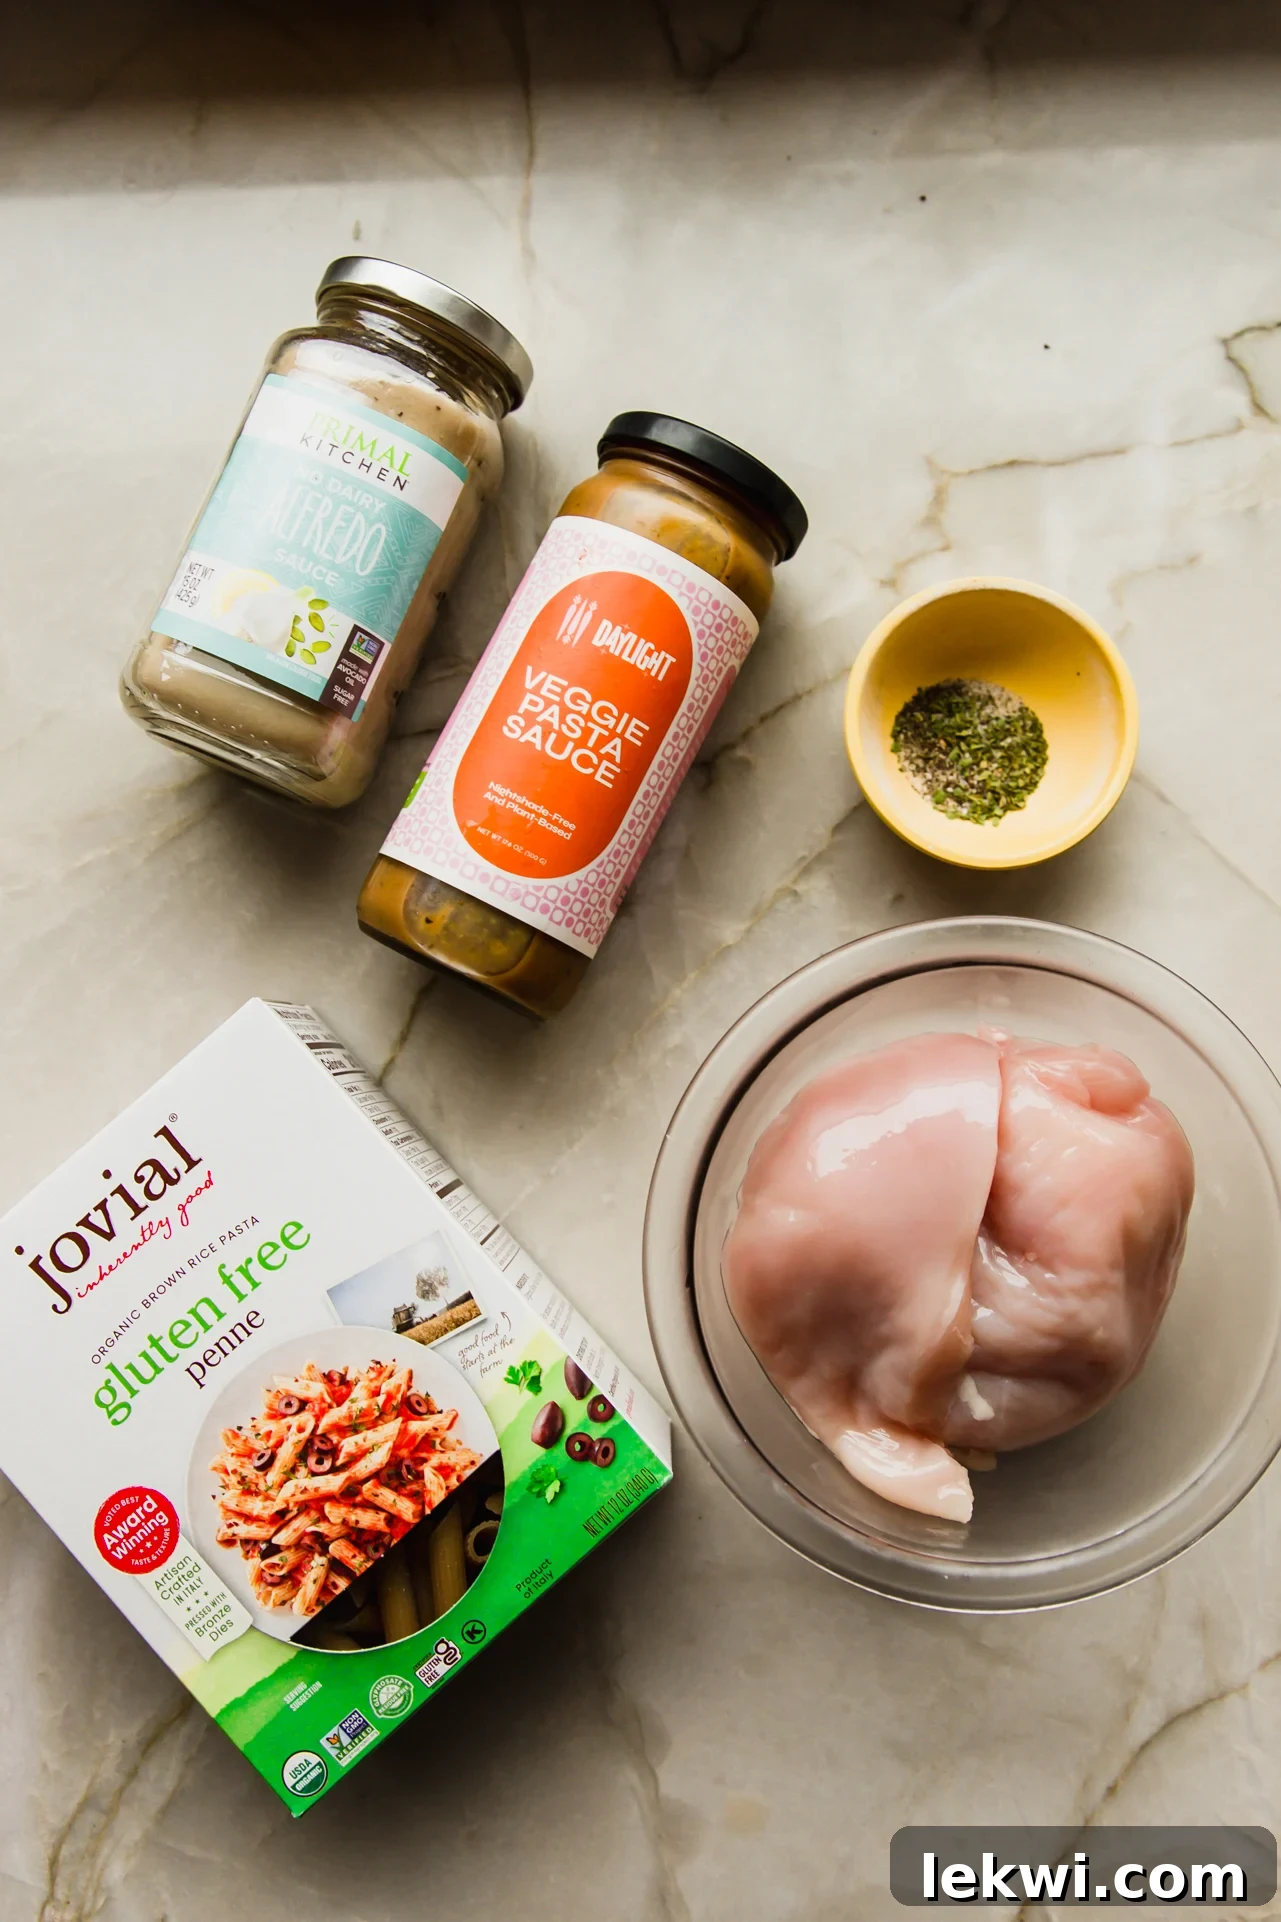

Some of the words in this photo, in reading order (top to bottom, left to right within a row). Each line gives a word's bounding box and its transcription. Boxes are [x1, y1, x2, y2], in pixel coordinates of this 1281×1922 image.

[300, 433, 408, 491] KITCHEN
[309, 411, 412, 477] PRIMAL
[325, 477, 386, 514] DAIRY
[257, 479, 387, 577] ALFREDO
[187, 561, 202, 576] NET
[189, 578, 201, 590] OZ
[273, 548, 340, 587] SAUCE
[591, 618, 677, 681] DAYLIGHT
[336, 663, 367, 684] AVOCADO
[345, 676, 355, 687] OIL
[333, 685, 355, 701] SUGAR
[333, 693, 350, 707] FREE
[524, 665, 650, 747] VEGGIE
[518, 693, 622, 764] PASTA
[502, 715, 621, 789] SAUCE
[483, 791, 507, 806] And
[506, 801, 572, 840] Plant-Based
[488, 781, 576, 831] Nightshade-Free
[476, 826, 491, 836] NET
[491, 833, 502, 842] WT
[75, 1216, 172, 1299] inherently
[177, 1170, 214, 1228] good
[91, 1308, 141, 1365] ORGANIC
[141, 1266, 187, 1310] BROWN
[187, 1243, 218, 1269] RICE
[219, 1215, 260, 1245] PASTA
[93, 1296, 227, 1426] gluten
[217, 1220, 311, 1304] free
[184, 1309, 266, 1389] penne
[458, 1334, 479, 1364] good
[481, 1322, 499, 1346] food
[487, 1343, 498, 1357] at
[499, 1334, 516, 1350] the
[103, 1503, 121, 1527] VOTED
[120, 1495, 140, 1507] BEST
[103, 1494, 158, 1551] Award
[582, 1515, 604, 1538] NET
[607, 1498, 624, 1515] 12
[616, 1488, 634, 1507] OZ
[111, 1511, 169, 1560] Winning
[131, 1556, 152, 1566] TASTE
[151, 1553, 157, 1561] &
[155, 1527, 171, 1556] TEXTURE
[154, 1555, 193, 1591] Artisan
[160, 1561, 202, 1600] Crafted
[173, 1594, 185, 1606] IN
[182, 1576, 204, 1598] ITALY
[515, 1558, 552, 1592] Product
[523, 1587, 534, 1599] of
[533, 1570, 554, 1591] Italy
[184, 1605, 212, 1631] PRESSED
[209, 1592, 227, 1608] WITH
[194, 1604, 232, 1638] Bronze
[208, 1619, 234, 1642] Dies
[419, 1655, 443, 1678] GLUTEN
[424, 1669, 440, 1685] FREE
[372, 1677, 403, 1707] GLYPHOSATE
[341, 1711, 360, 1729] NON
[346, 1717, 364, 1734] GMO
[288, 1758, 313, 1780] USDA
[295, 1765, 323, 1792] ORGANIC
